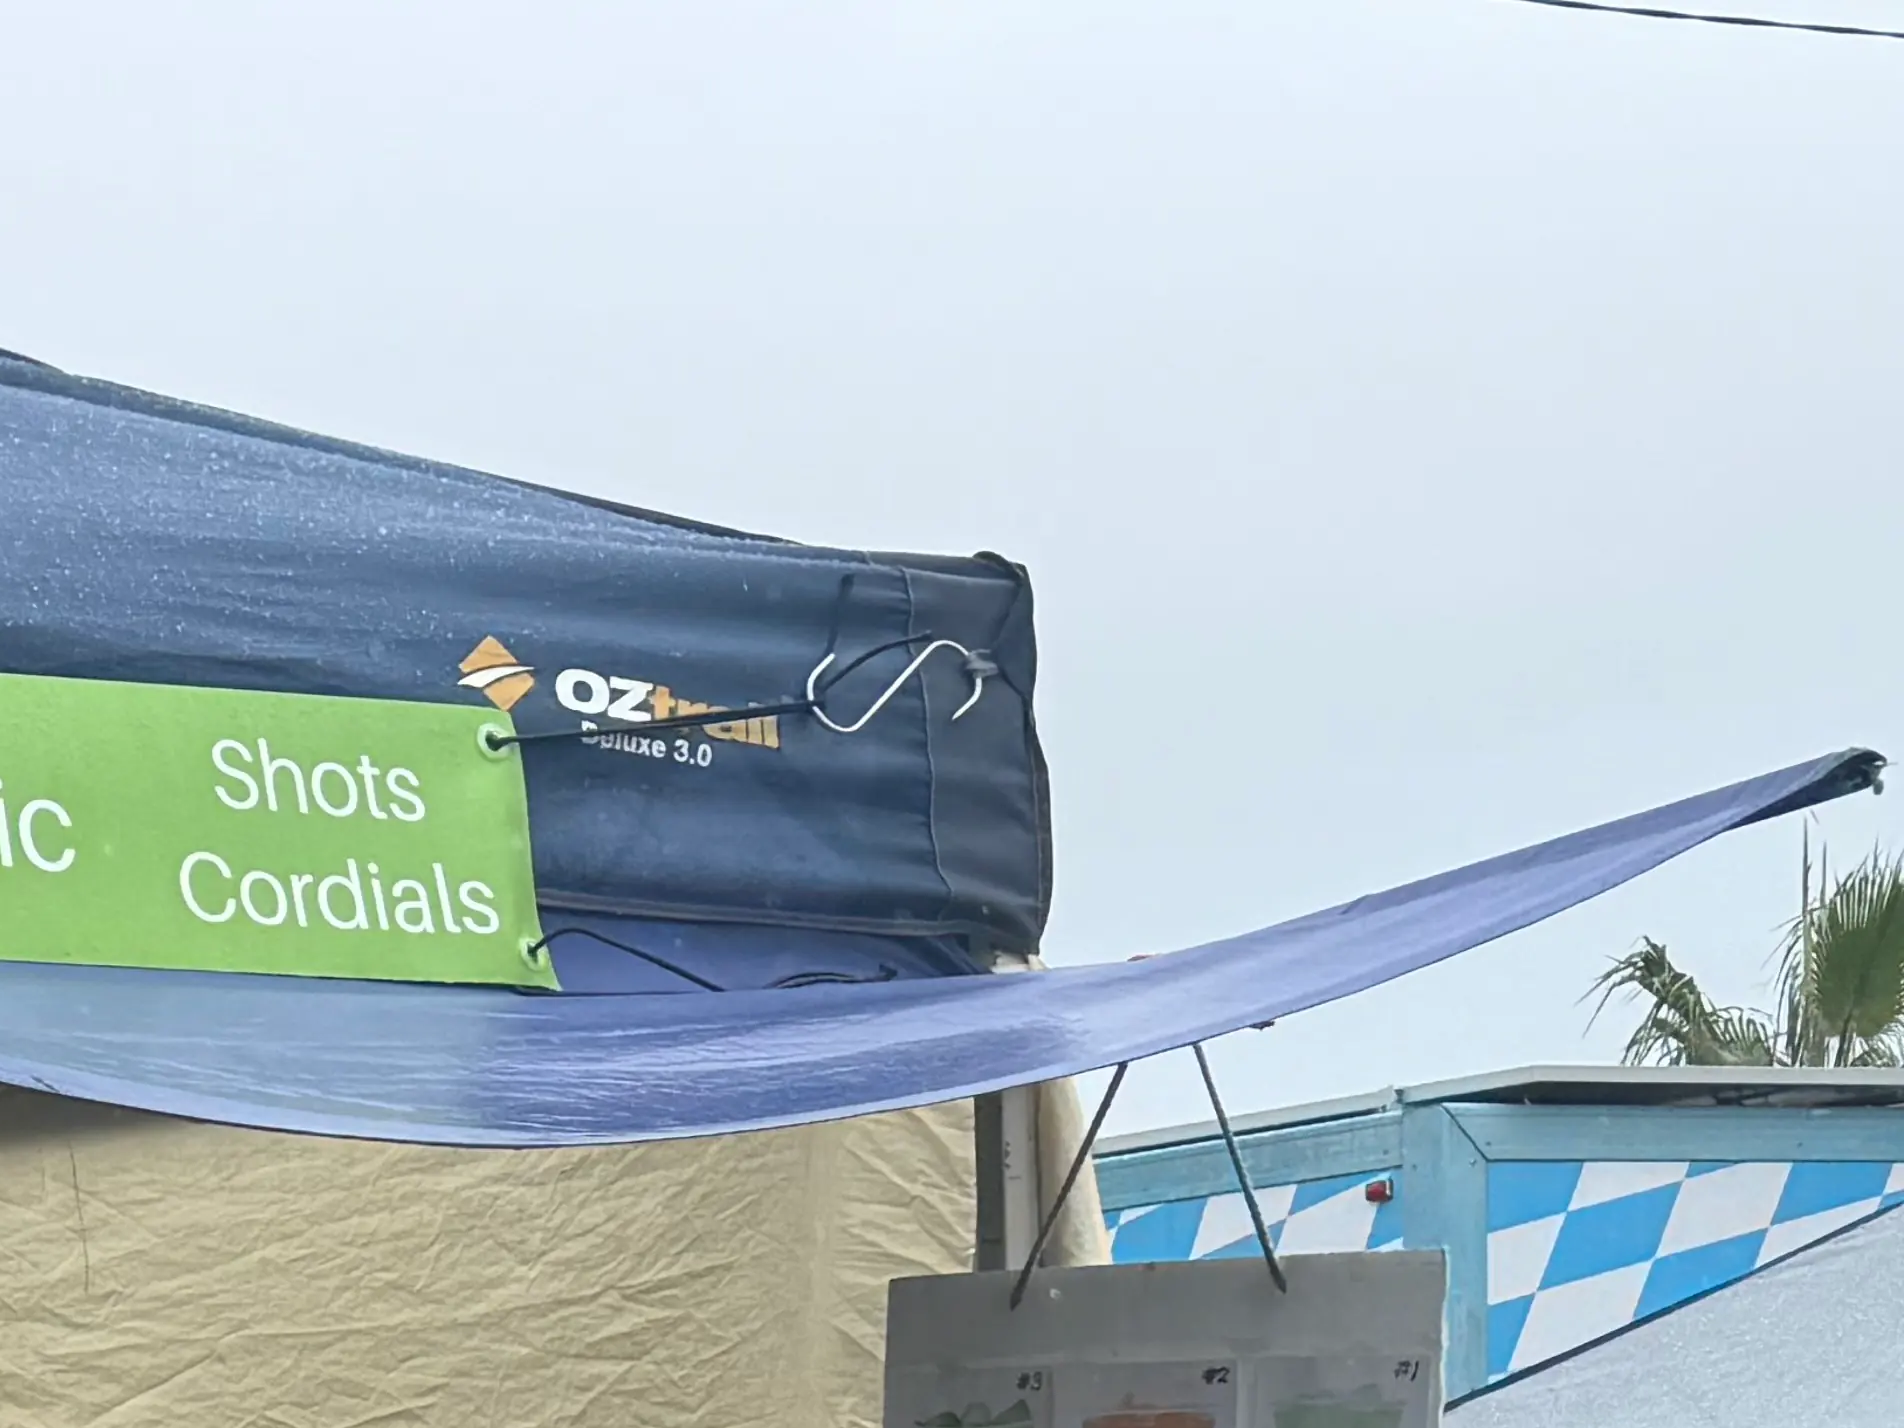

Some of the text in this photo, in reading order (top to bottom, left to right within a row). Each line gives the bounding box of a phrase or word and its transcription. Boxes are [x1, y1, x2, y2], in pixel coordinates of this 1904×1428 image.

[212, 738, 425, 821] Shots
[674, 739, 712, 767] 3.0
[180, 851, 501, 936] Cordials
[1202, 1367, 1230, 1384] #2
